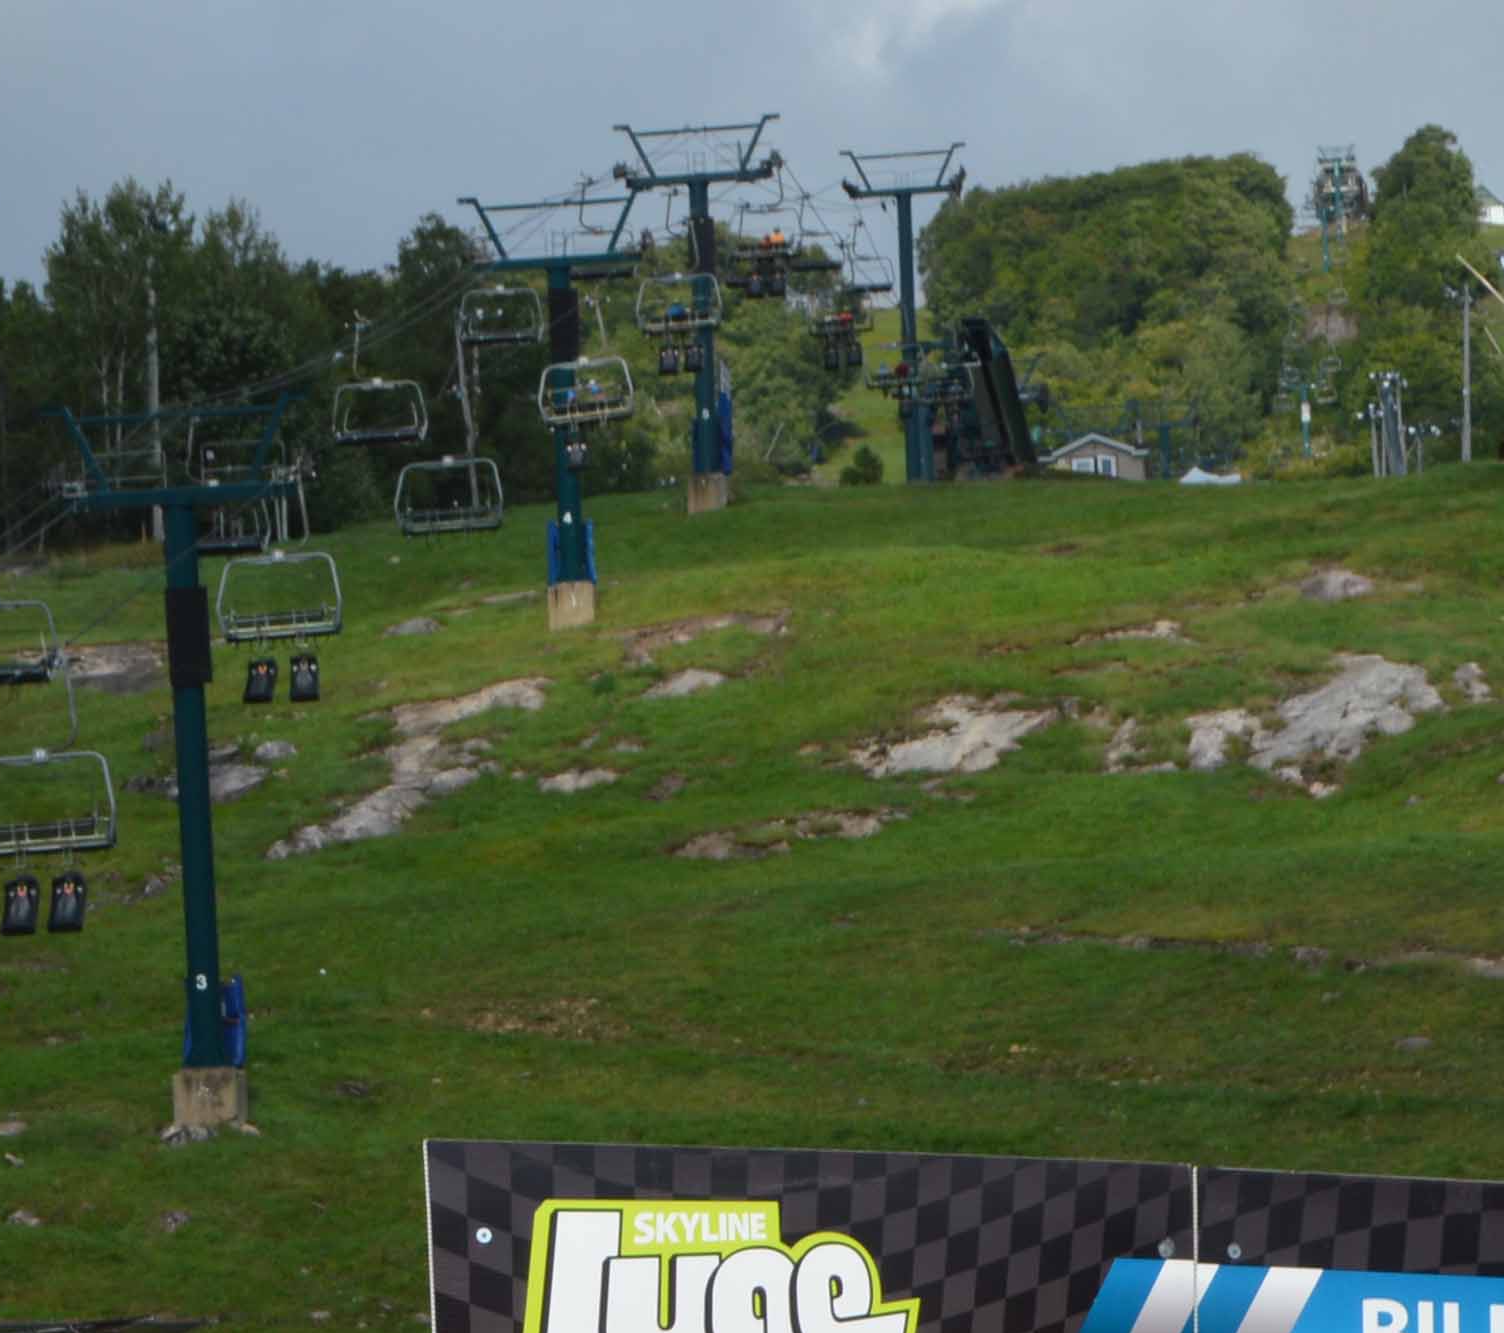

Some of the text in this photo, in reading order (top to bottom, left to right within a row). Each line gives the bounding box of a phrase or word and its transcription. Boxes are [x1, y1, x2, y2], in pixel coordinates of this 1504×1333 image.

[563, 512, 572, 524] 4
[196, 974, 208, 990] 3
[633, 1211, 767, 1245] SKYLINE
